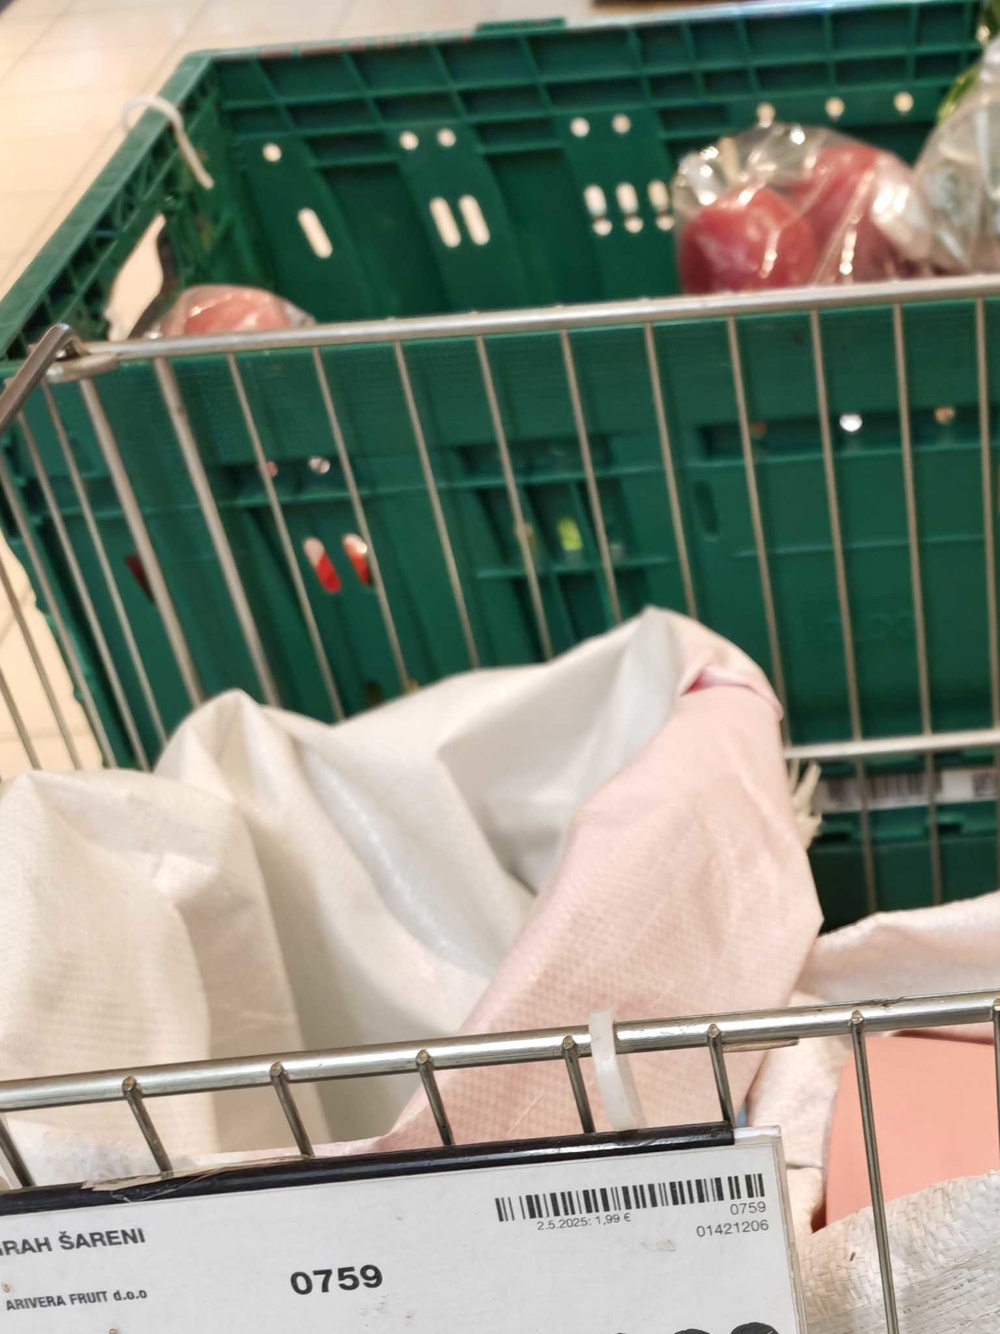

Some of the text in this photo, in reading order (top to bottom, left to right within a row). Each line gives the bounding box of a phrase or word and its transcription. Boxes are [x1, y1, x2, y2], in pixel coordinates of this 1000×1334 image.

[730, 1201, 767, 1215] 0759
[537, 1212, 632, 1231] 2.5.2025: 1,99 €
[697, 1220, 769, 1237] 01421206
[58, 1228, 146, 1250] ŠARENI
[290, 1264, 383, 1296] 0759
[6, 1289, 147, 1310] ARIVERA FRUIT d.o.o
